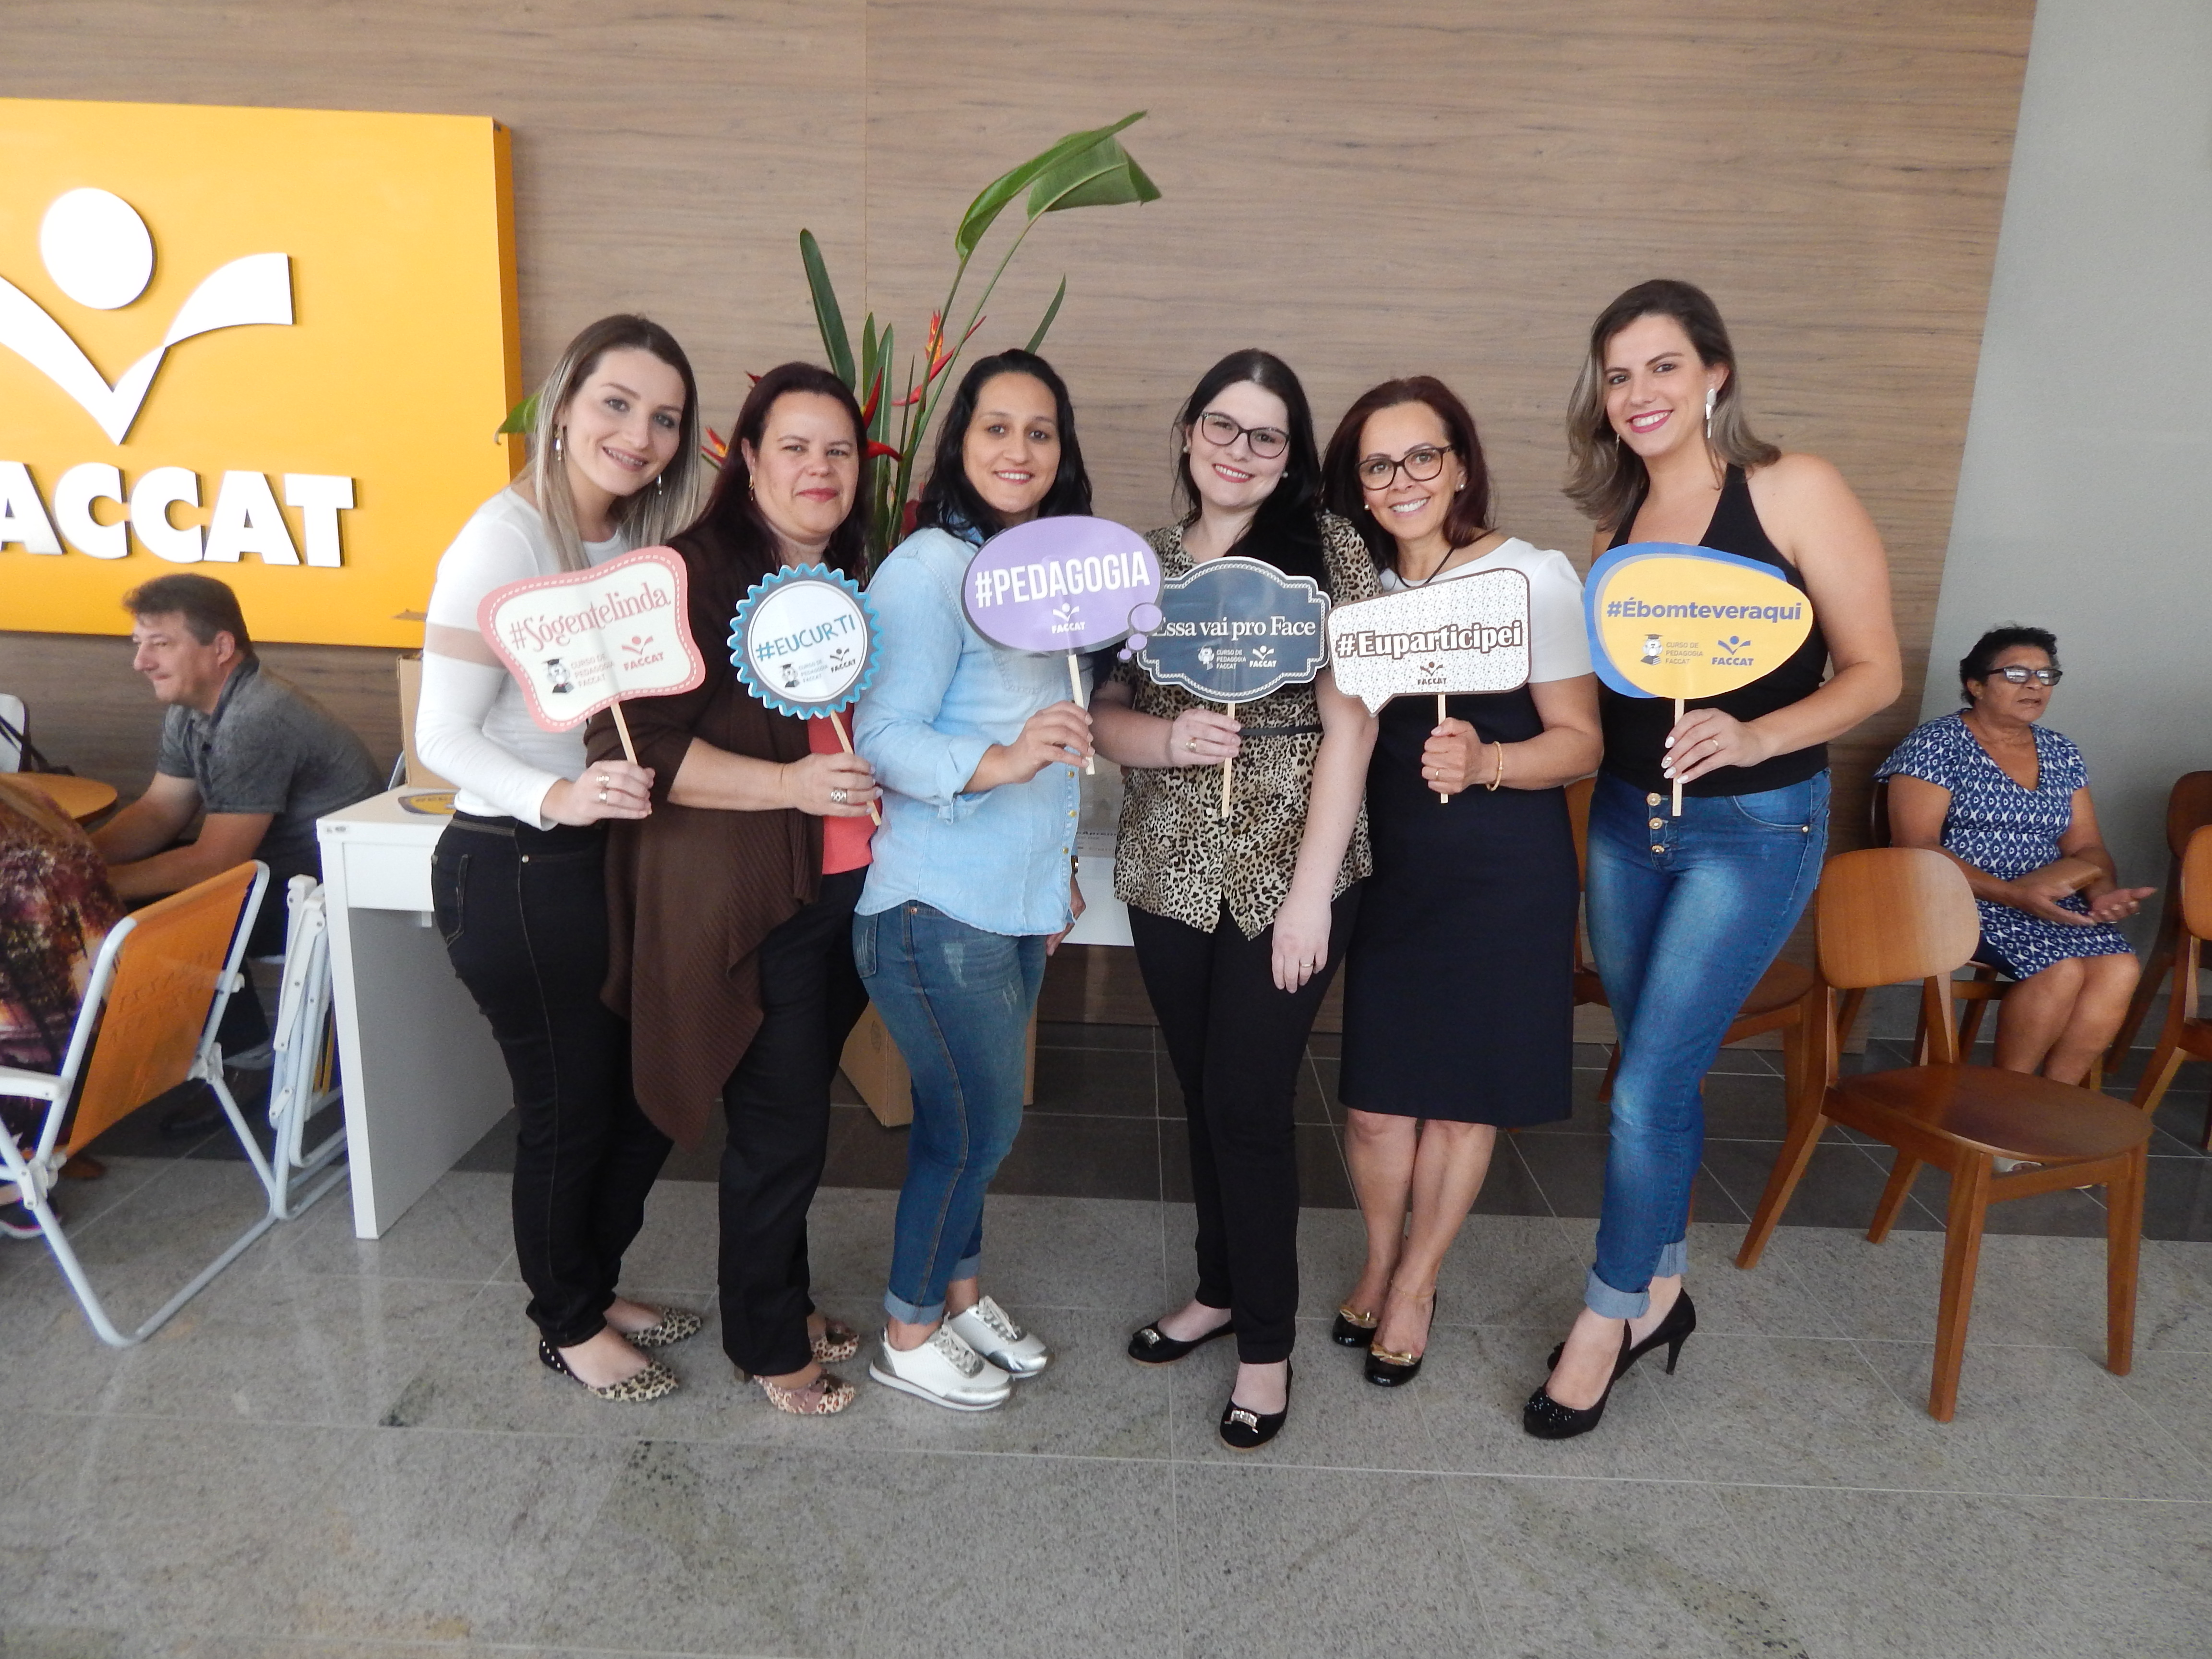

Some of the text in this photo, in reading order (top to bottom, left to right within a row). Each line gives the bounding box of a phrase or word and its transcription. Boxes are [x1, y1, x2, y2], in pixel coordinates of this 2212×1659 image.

[975, 551, 1151, 608] #PEDAGOGIA
[509, 582, 671, 652] #Sógentelinda
[1607, 597, 1801, 623] #Ébomteveraqui
[755, 614, 855, 661] #EUCURTI
[1051, 621, 1085, 634] FACCAT
[1200, 617, 1229, 636] vai
[1231, 621, 1266, 641] pro
[1270, 616, 1316, 636] Face
[1335, 620, 1523, 660] #Euparticipei
[624, 651, 664, 671] FACCAT
[1711, 657, 1755, 666] FACCAT
[1417, 677, 1447, 685] FACCAT
